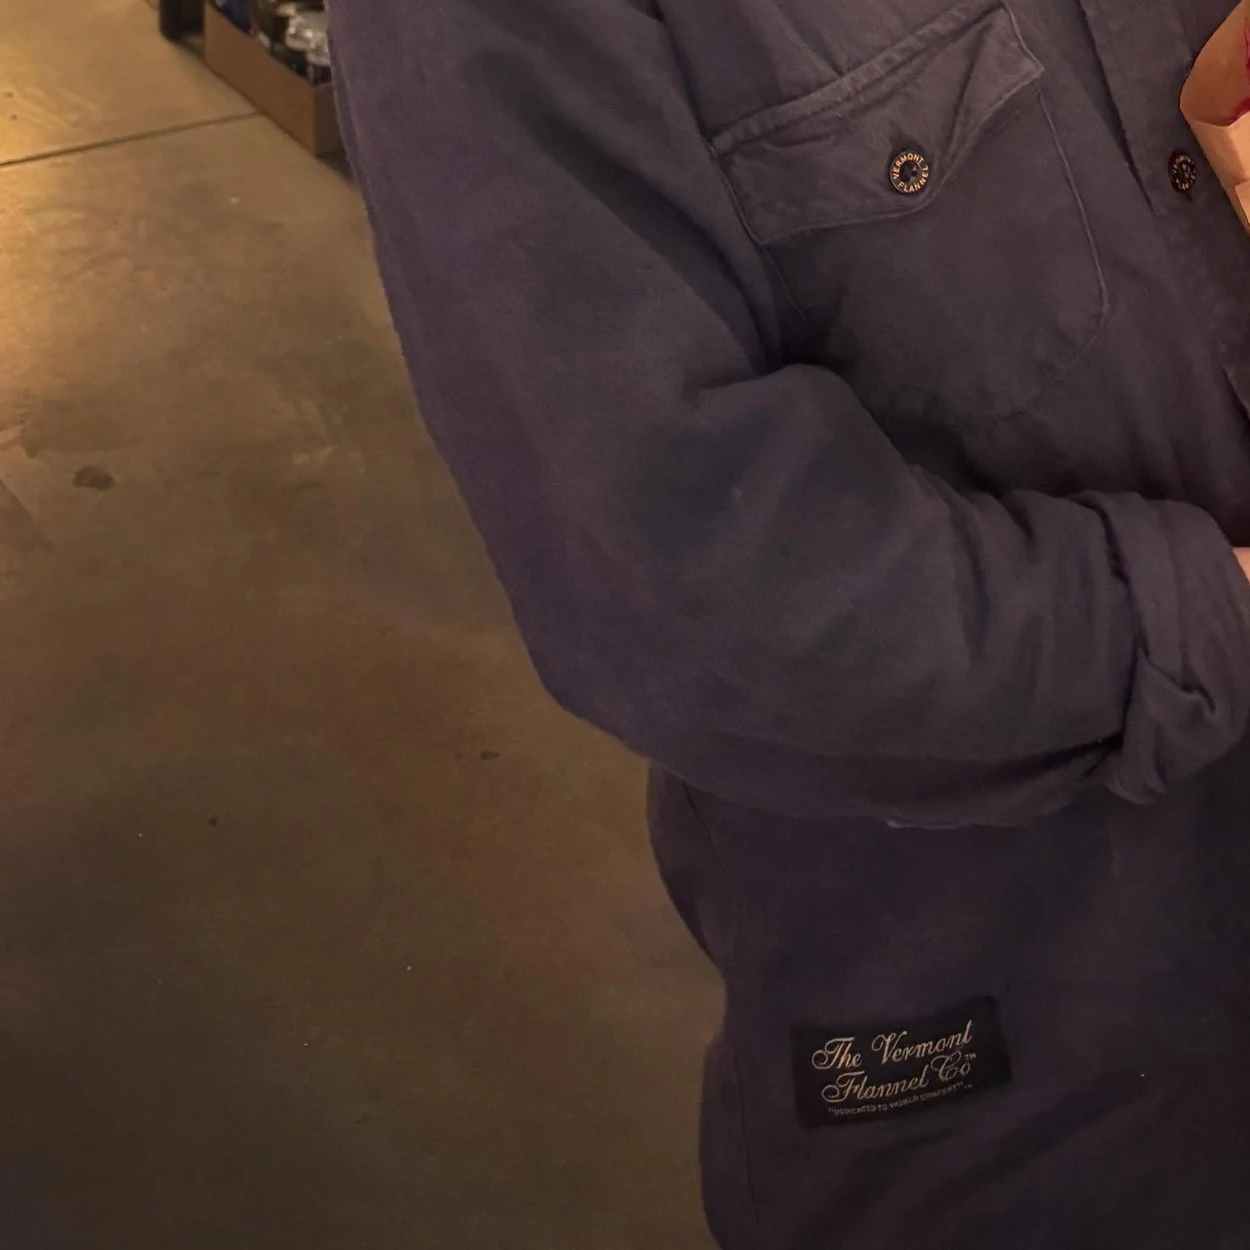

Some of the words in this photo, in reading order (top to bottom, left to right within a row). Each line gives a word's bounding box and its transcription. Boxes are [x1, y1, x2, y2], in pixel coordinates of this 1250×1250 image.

[892, 152, 925, 180] VERMONT
[811, 1036, 863, 1070] The
[871, 1019, 974, 1066] Vermont
[821, 1064, 930, 1103] Flannel
